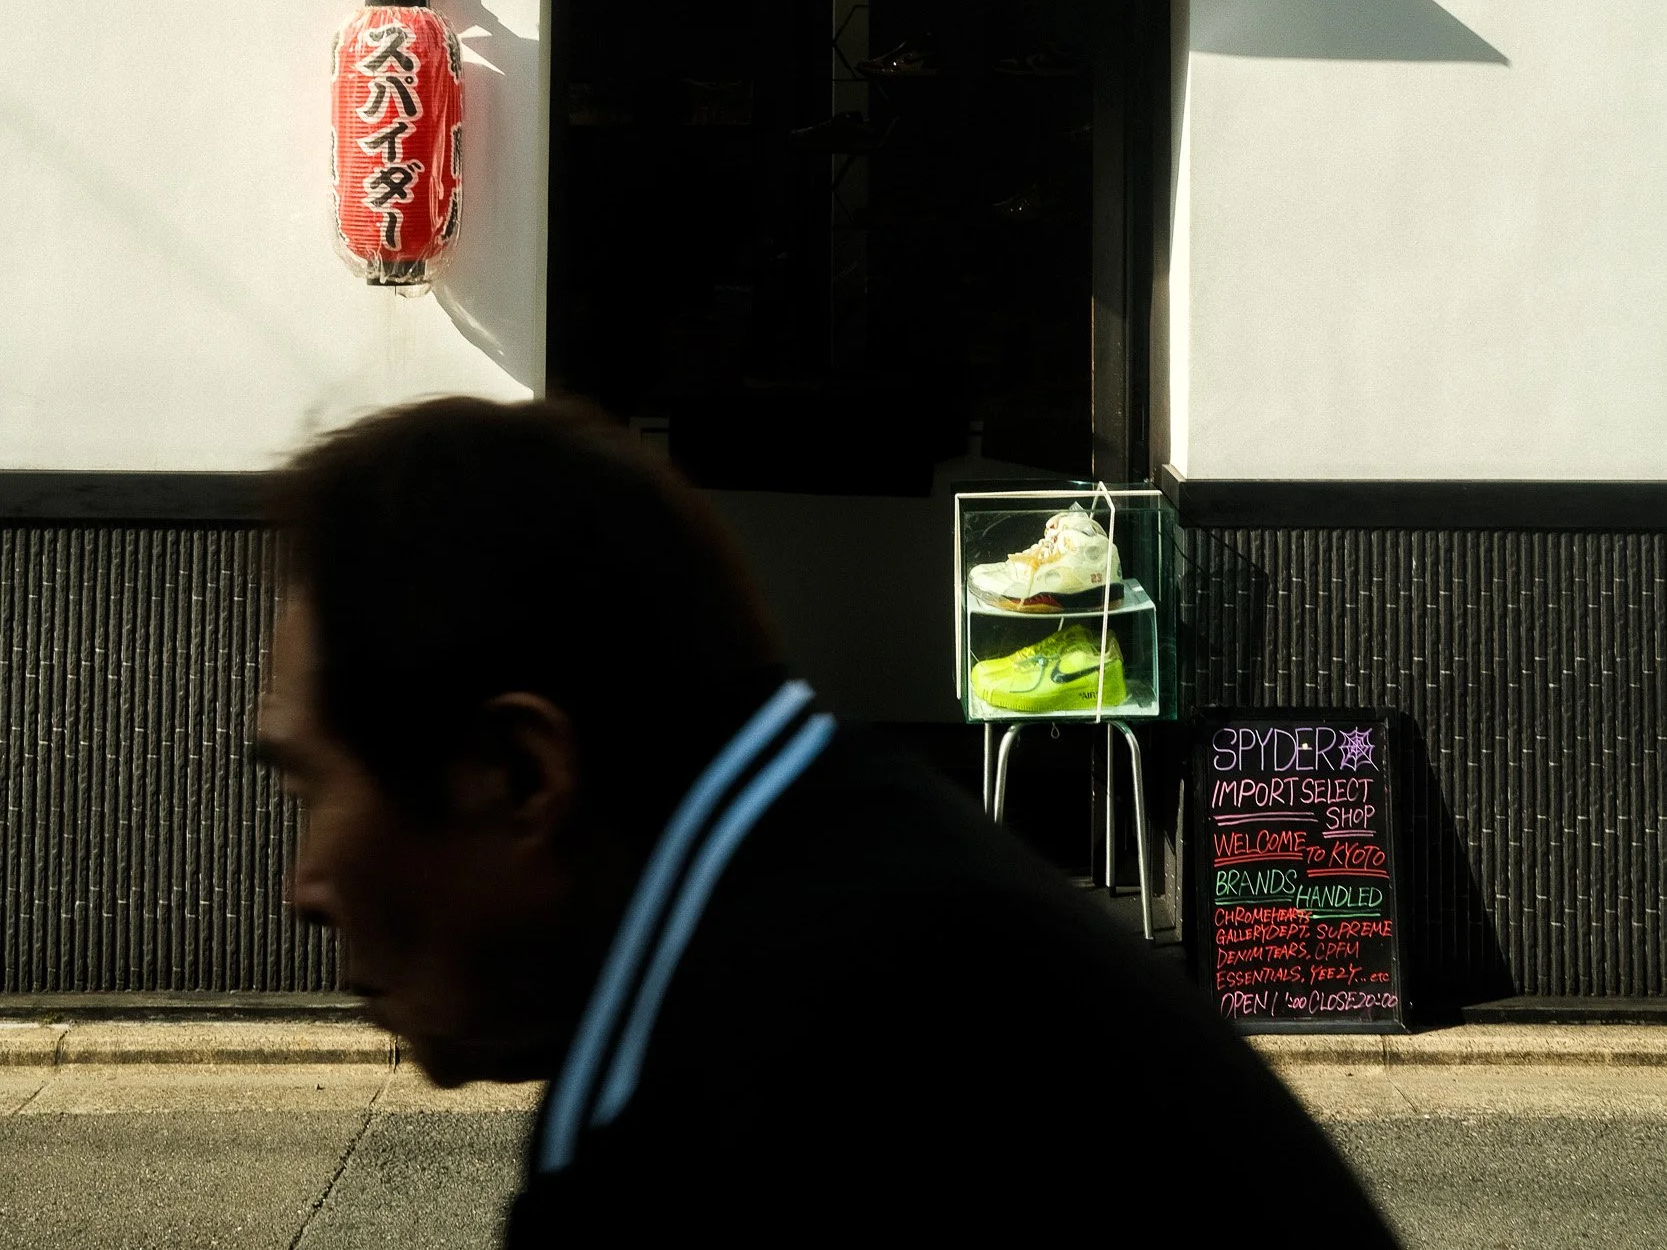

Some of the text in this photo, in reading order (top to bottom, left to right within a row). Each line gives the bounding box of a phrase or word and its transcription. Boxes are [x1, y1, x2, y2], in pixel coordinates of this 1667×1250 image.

[356, 22, 425, 250] スパイダー
[1212, 727, 1336, 771] SPYDER
[1211, 777, 1374, 808] IMPORT SELECT
[1326, 804, 1375, 830] SHOP
[1213, 829, 1386, 870] WELCOME TO KYOTO
[1215, 868, 1383, 909] BRANDS HANDLED
[1216, 946, 1264, 970] DENIM
[1220, 989, 1269, 1020] OPEN
